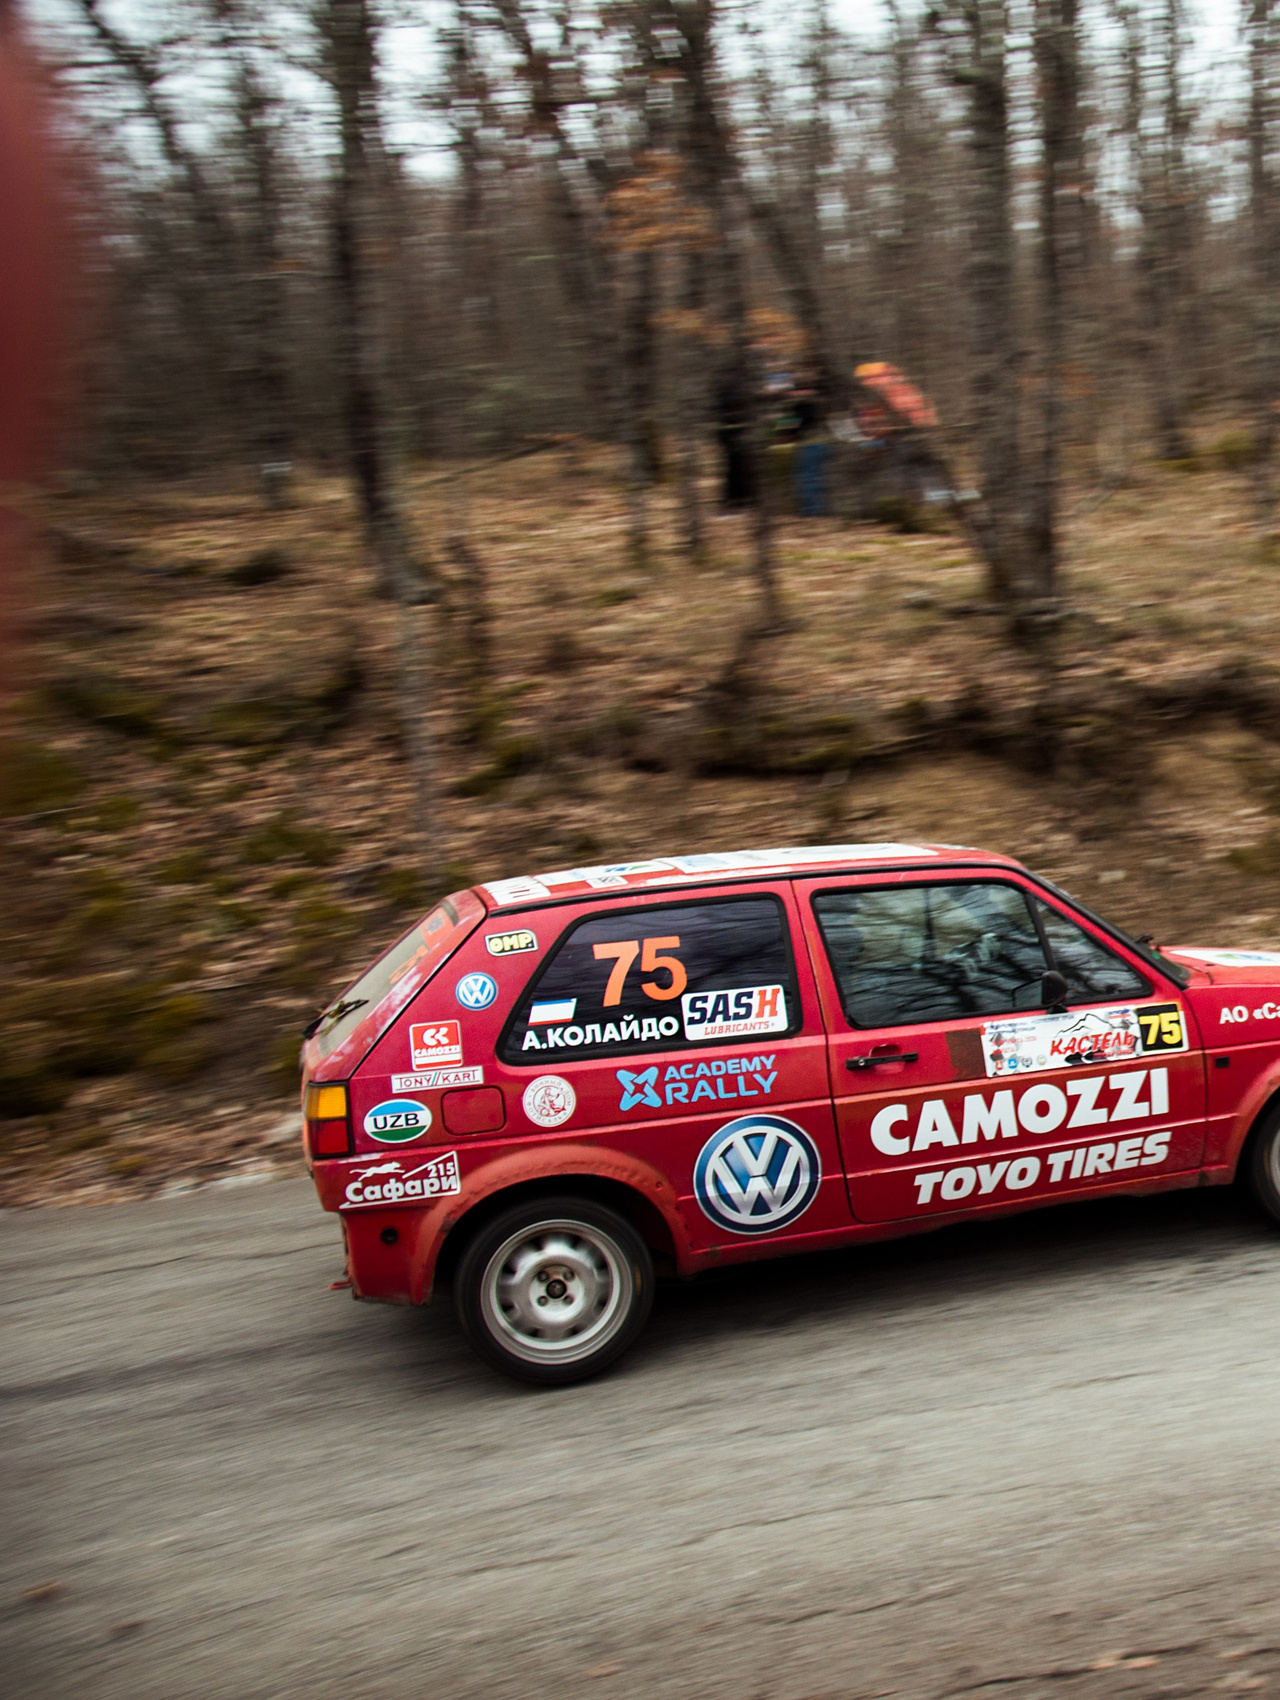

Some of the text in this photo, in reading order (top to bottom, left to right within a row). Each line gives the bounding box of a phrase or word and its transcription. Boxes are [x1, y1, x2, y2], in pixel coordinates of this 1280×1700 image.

[592, 936, 687, 1007] 75
[687, 988, 780, 1026] SASH
[1219, 1005, 1248, 1024] АО
[522, 1014, 679, 1050] А.КОЛАЙДО
[704, 1021, 770, 1036] LUBRICANTS
[1138, 1012, 1183, 1046] 75
[414, 1045, 460, 1057] CAMOZZI
[1050, 1030, 1135, 1056] КАСТЕЛЬ
[664, 1054, 776, 1081] ACADEMY
[665, 1071, 778, 1105] RALLY
[373, 1113, 420, 1130] UZB
[870, 1067, 1169, 1156] CAMOZZI
[427, 1162, 455, 1178] 215
[913, 1131, 1173, 1205] TOYO TIRES
[345, 1176, 458, 1203] Сафари
